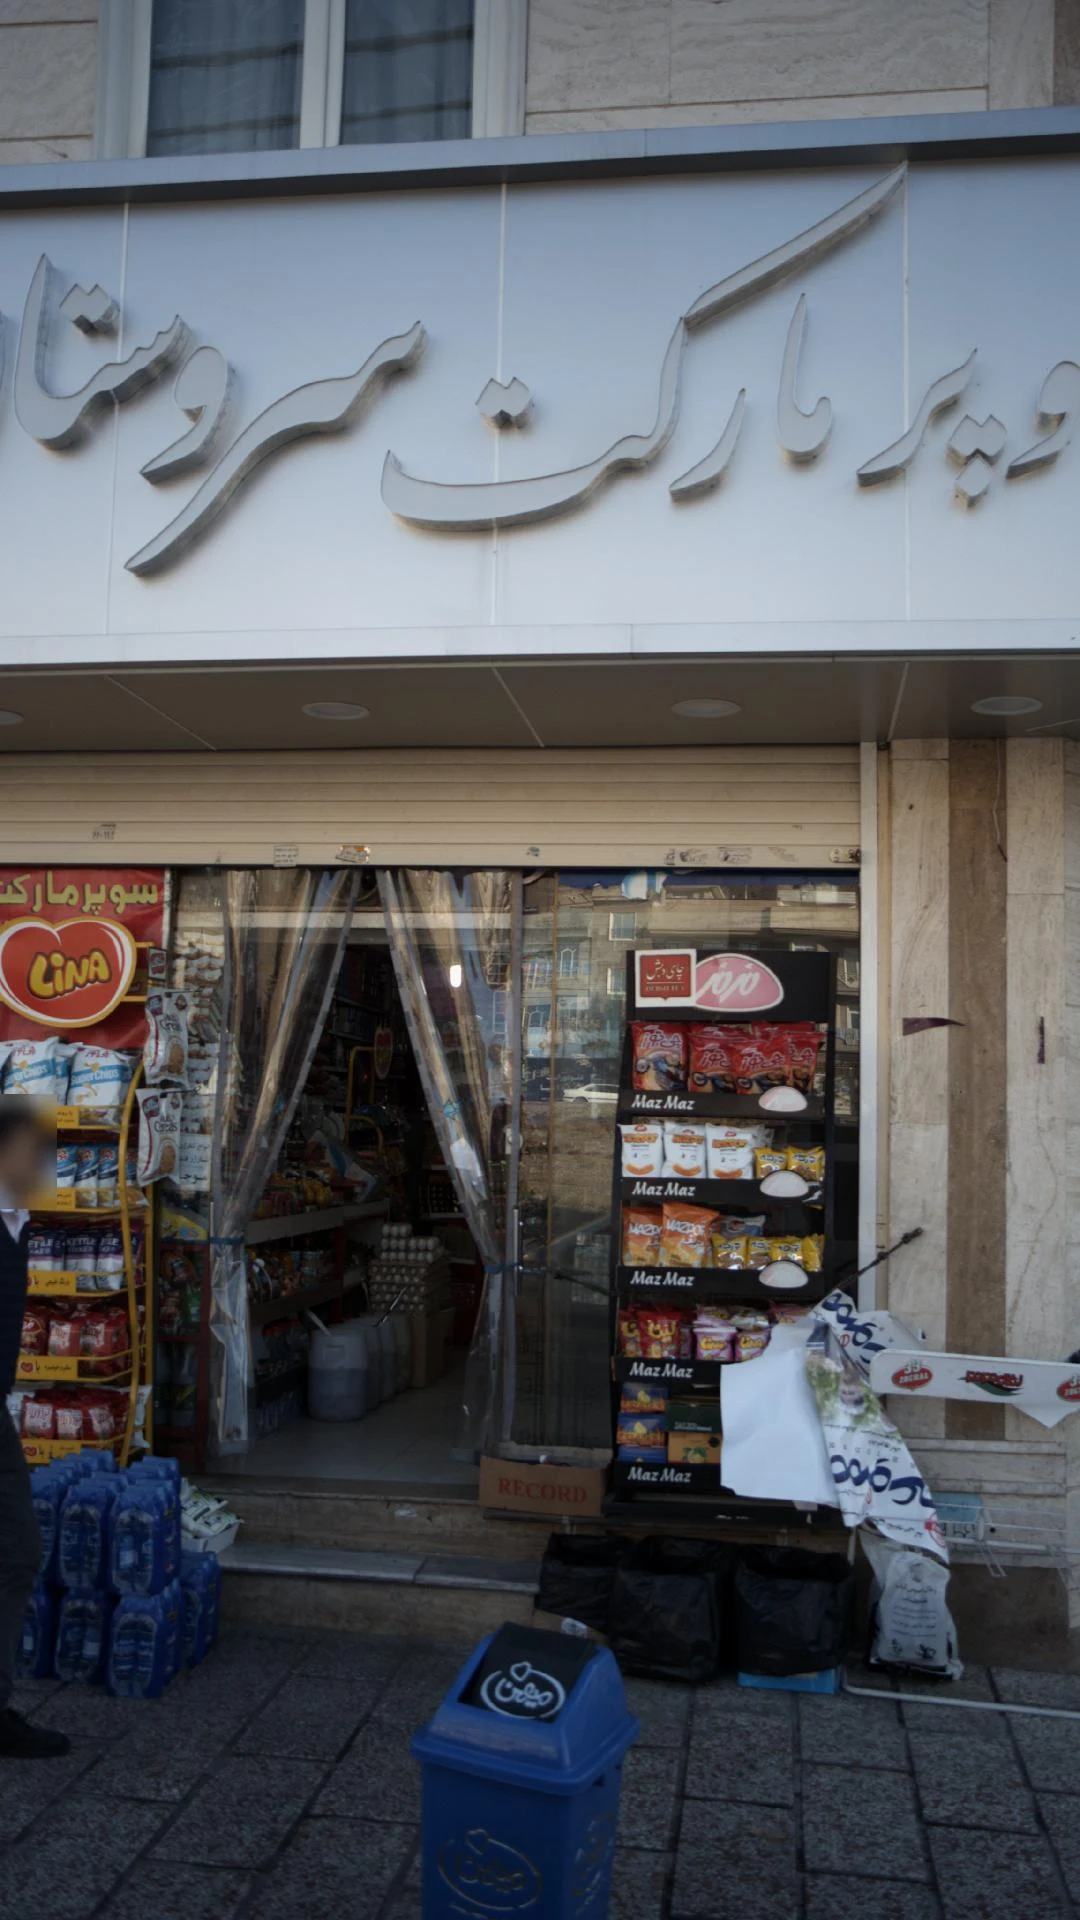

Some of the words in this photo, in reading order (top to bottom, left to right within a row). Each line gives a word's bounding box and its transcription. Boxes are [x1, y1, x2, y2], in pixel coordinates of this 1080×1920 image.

[381, 160, 1080, 532] وپرمارکت
[0, 252, 427, 577] سروستا
[631, 1094, 662, 1109] Maz
[663, 1095, 696, 1110] Maz
[631, 1181, 662, 1196] Maz
[663, 1182, 696, 1197] Maz
[630, 1270, 661, 1285] Maz
[662, 1271, 695, 1286] Maz
[629, 1361, 660, 1377] Maz
[661, 1362, 694, 1378] Maz
[627, 1466, 659, 1482] Maz
[659, 1467, 692, 1483] Maz
[497, 1477, 587, 1504] RECORD
